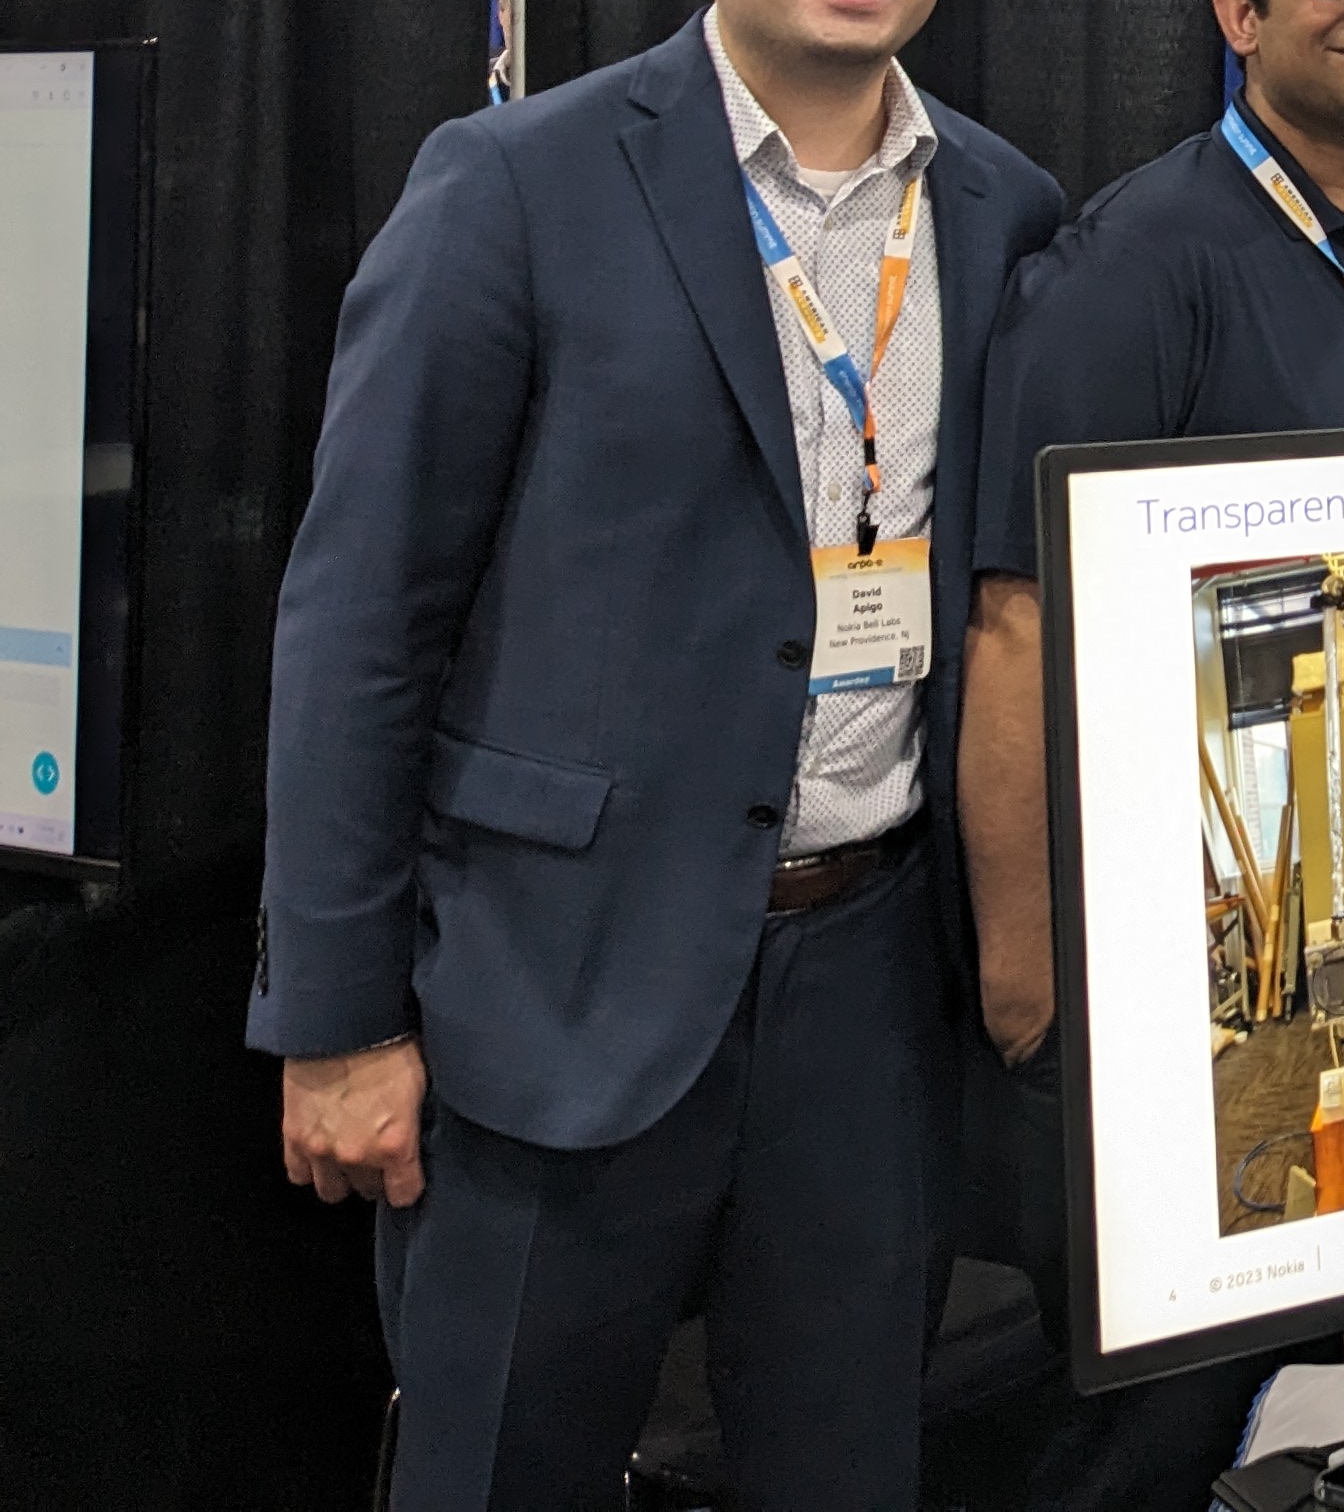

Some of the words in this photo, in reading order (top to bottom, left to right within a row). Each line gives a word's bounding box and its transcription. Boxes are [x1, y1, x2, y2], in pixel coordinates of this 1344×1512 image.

[852, 586, 882, 599] David
[853, 602, 883, 614] Apigo
[1226, 1269, 1263, 1291] 2023
[1267, 1259, 1305, 1280] Nokia
